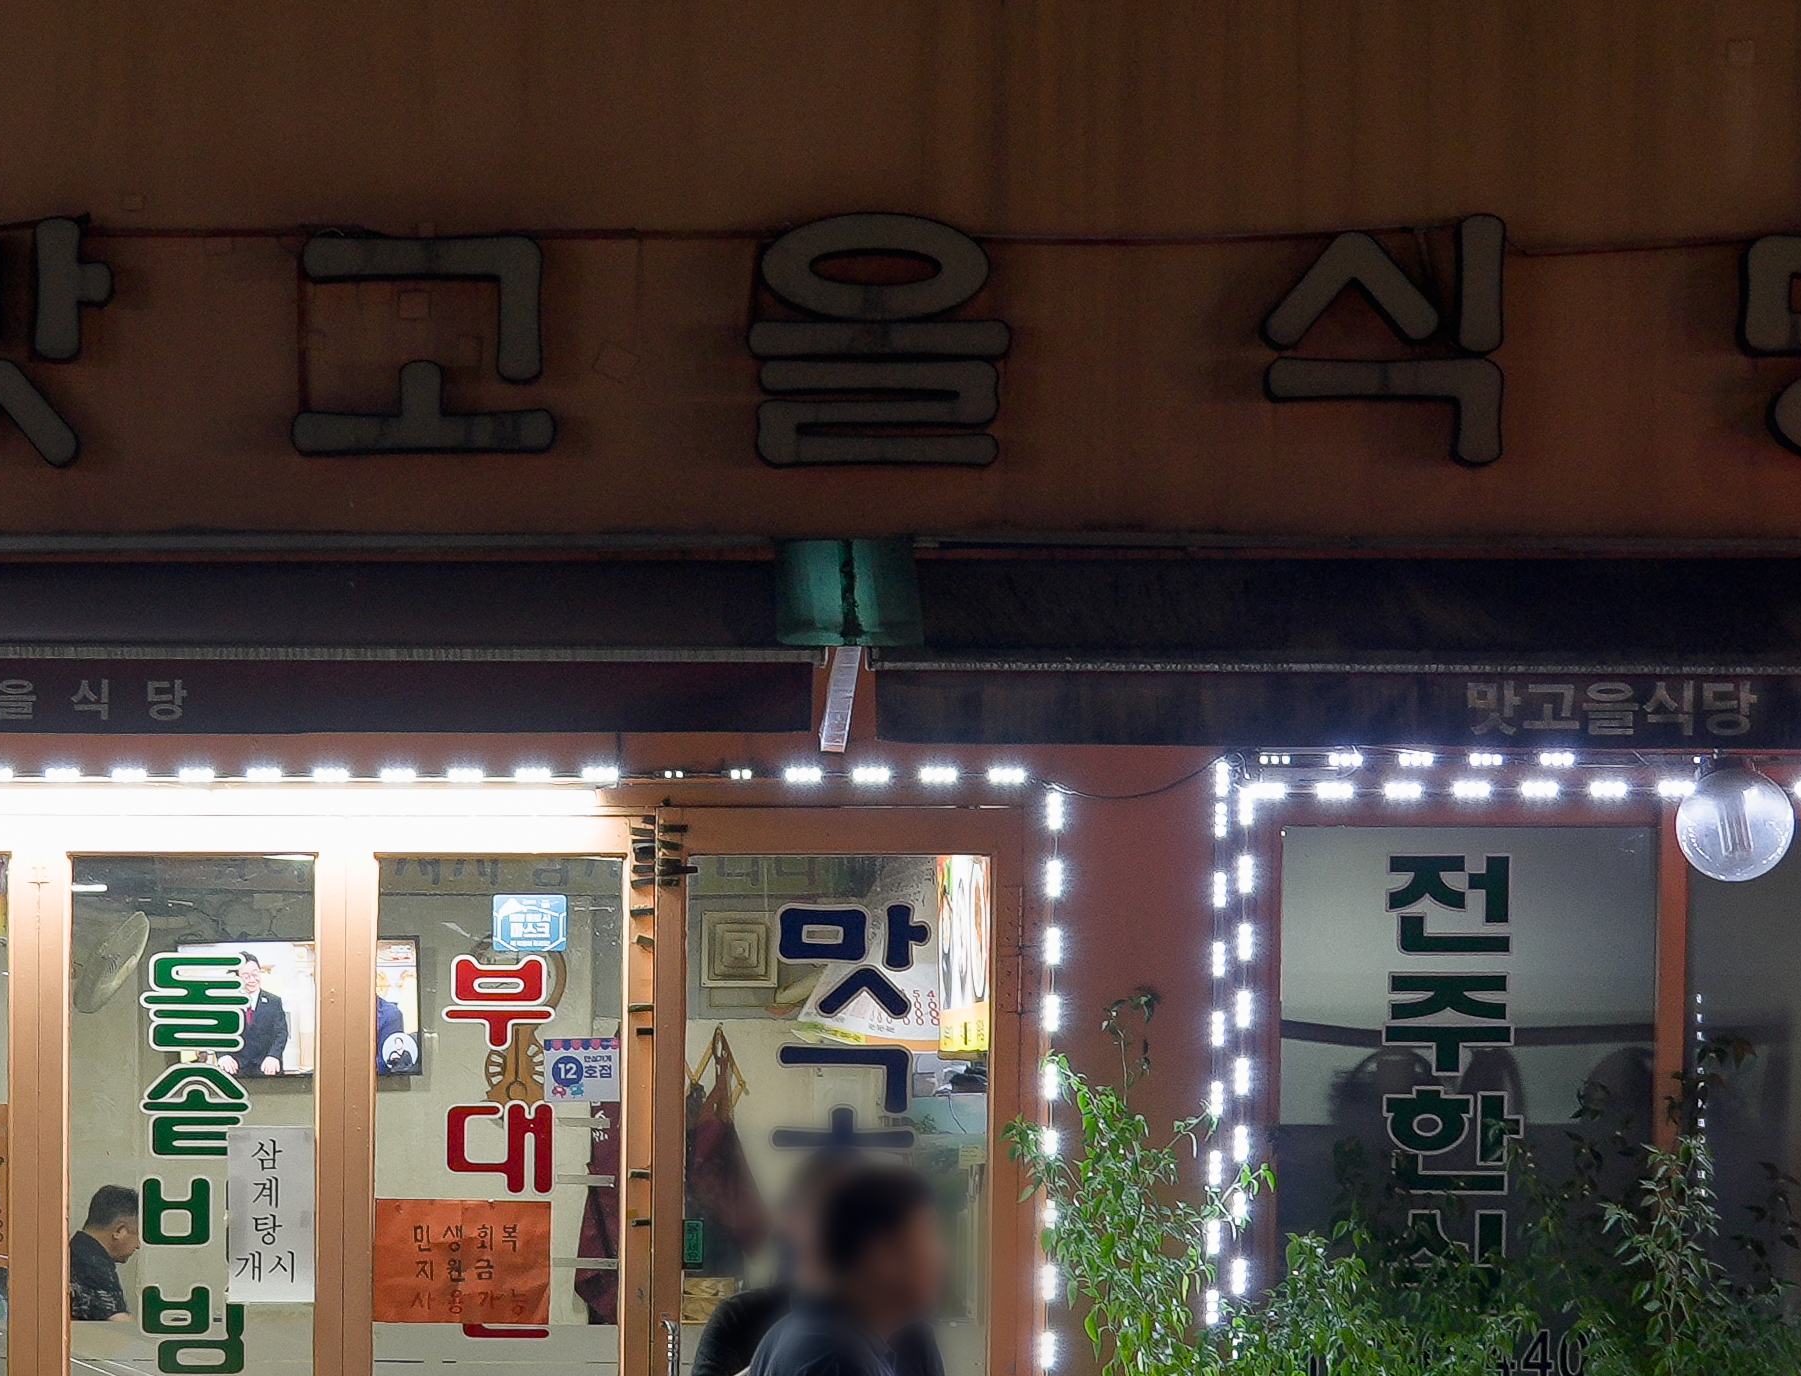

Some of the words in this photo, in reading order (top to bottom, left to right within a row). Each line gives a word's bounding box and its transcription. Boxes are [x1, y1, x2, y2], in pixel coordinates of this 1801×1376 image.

[1466, 680, 1759, 736] 맛고을식당
[557, 1063, 578, 1079] 12
[584, 1065, 612, 1079] 호점
[250, 1138, 284, 1246] 삼계탕
[234, 1250, 295, 1284] 개시
[415, 1258, 495, 1283] 지원금
